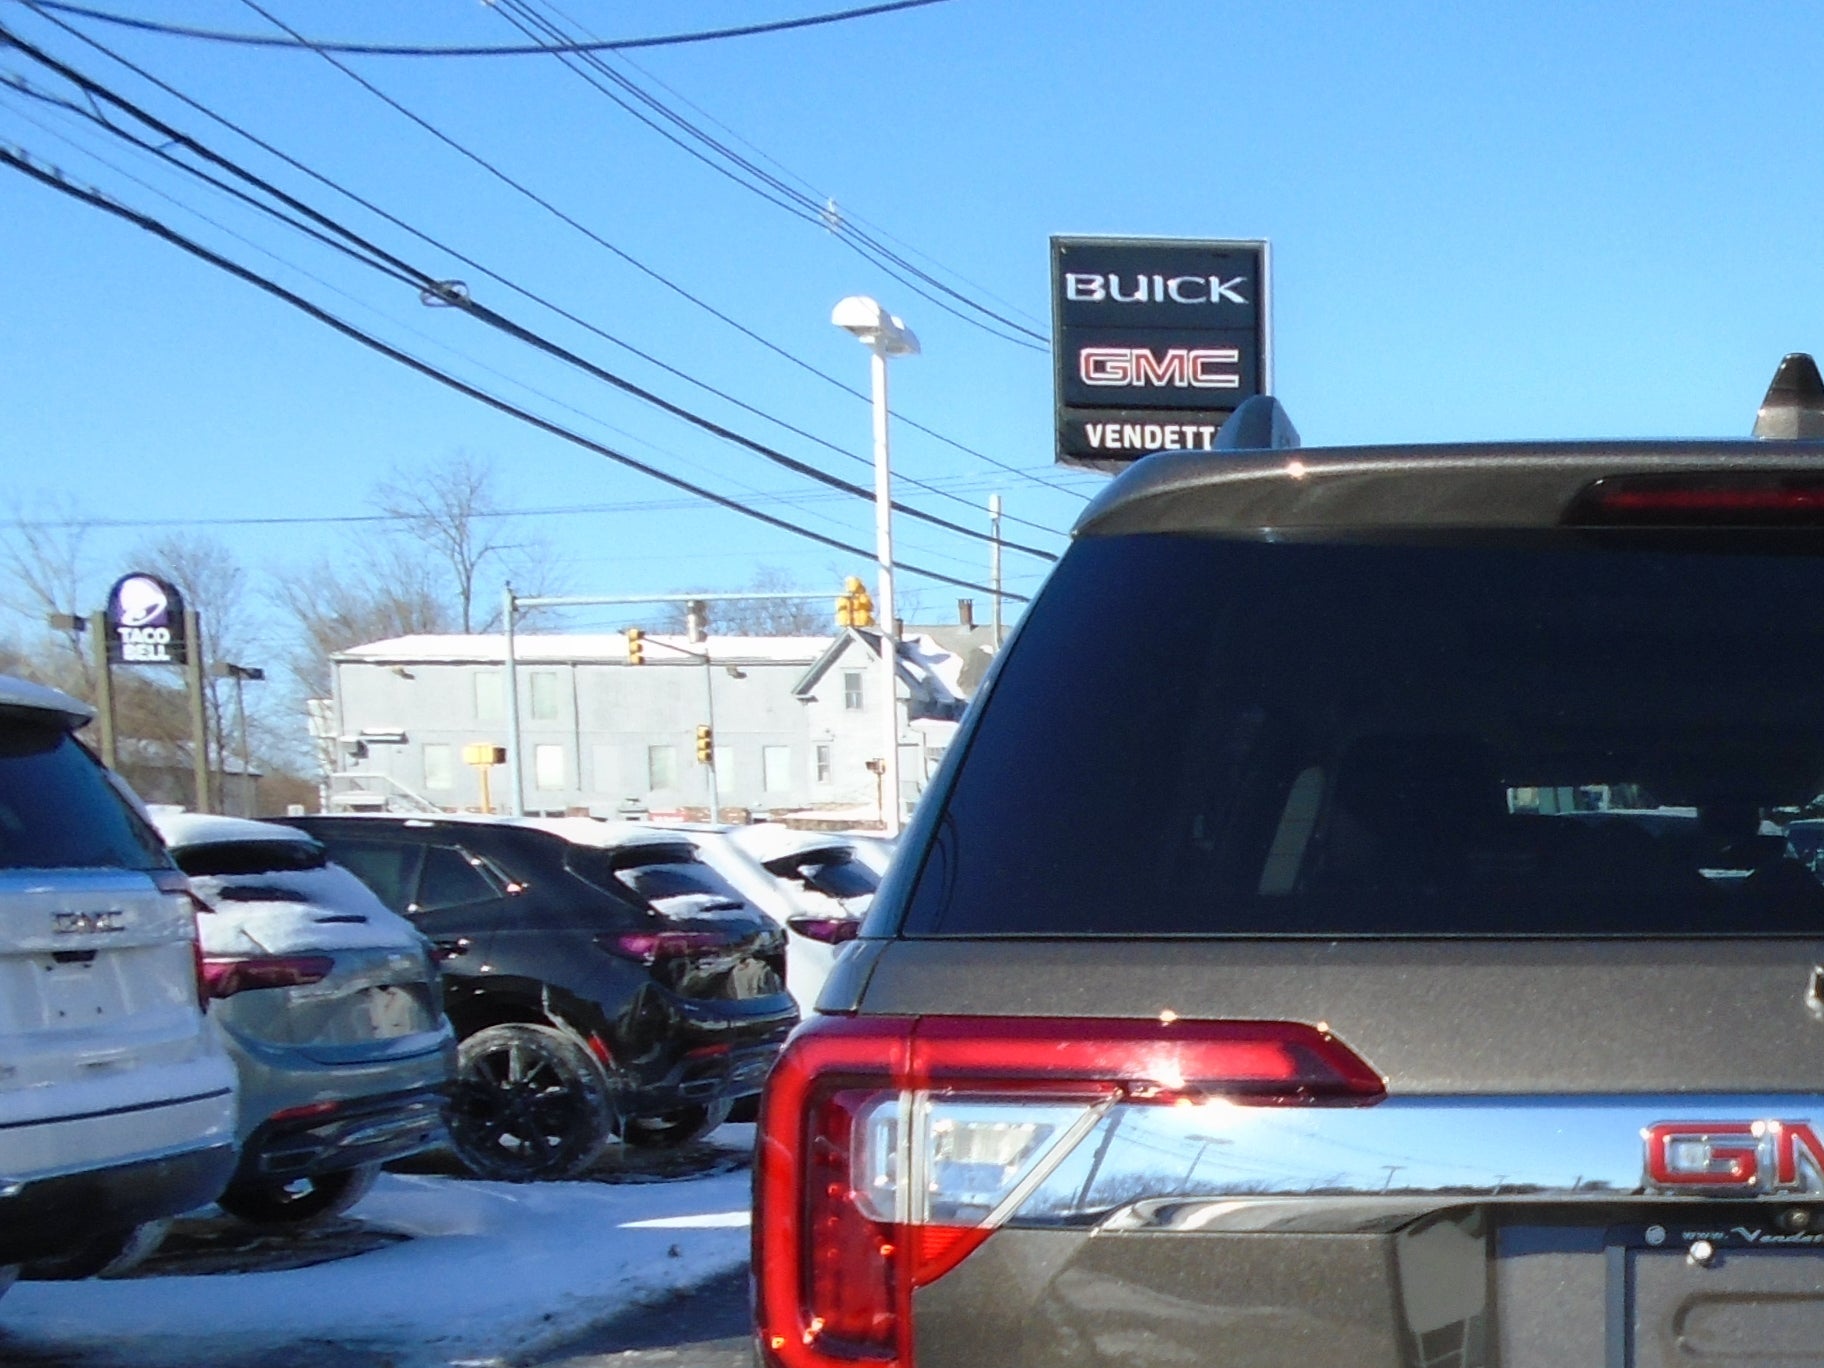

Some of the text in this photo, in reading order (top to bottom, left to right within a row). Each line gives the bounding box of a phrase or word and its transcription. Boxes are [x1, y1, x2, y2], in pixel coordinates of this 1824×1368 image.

[1064, 273, 1249, 303] BUICK
[1080, 348, 1239, 388] GMC
[1085, 424, 1223, 450] VENDETT
[117, 627, 171, 645] TACO
[122, 644, 171, 661] BELL
